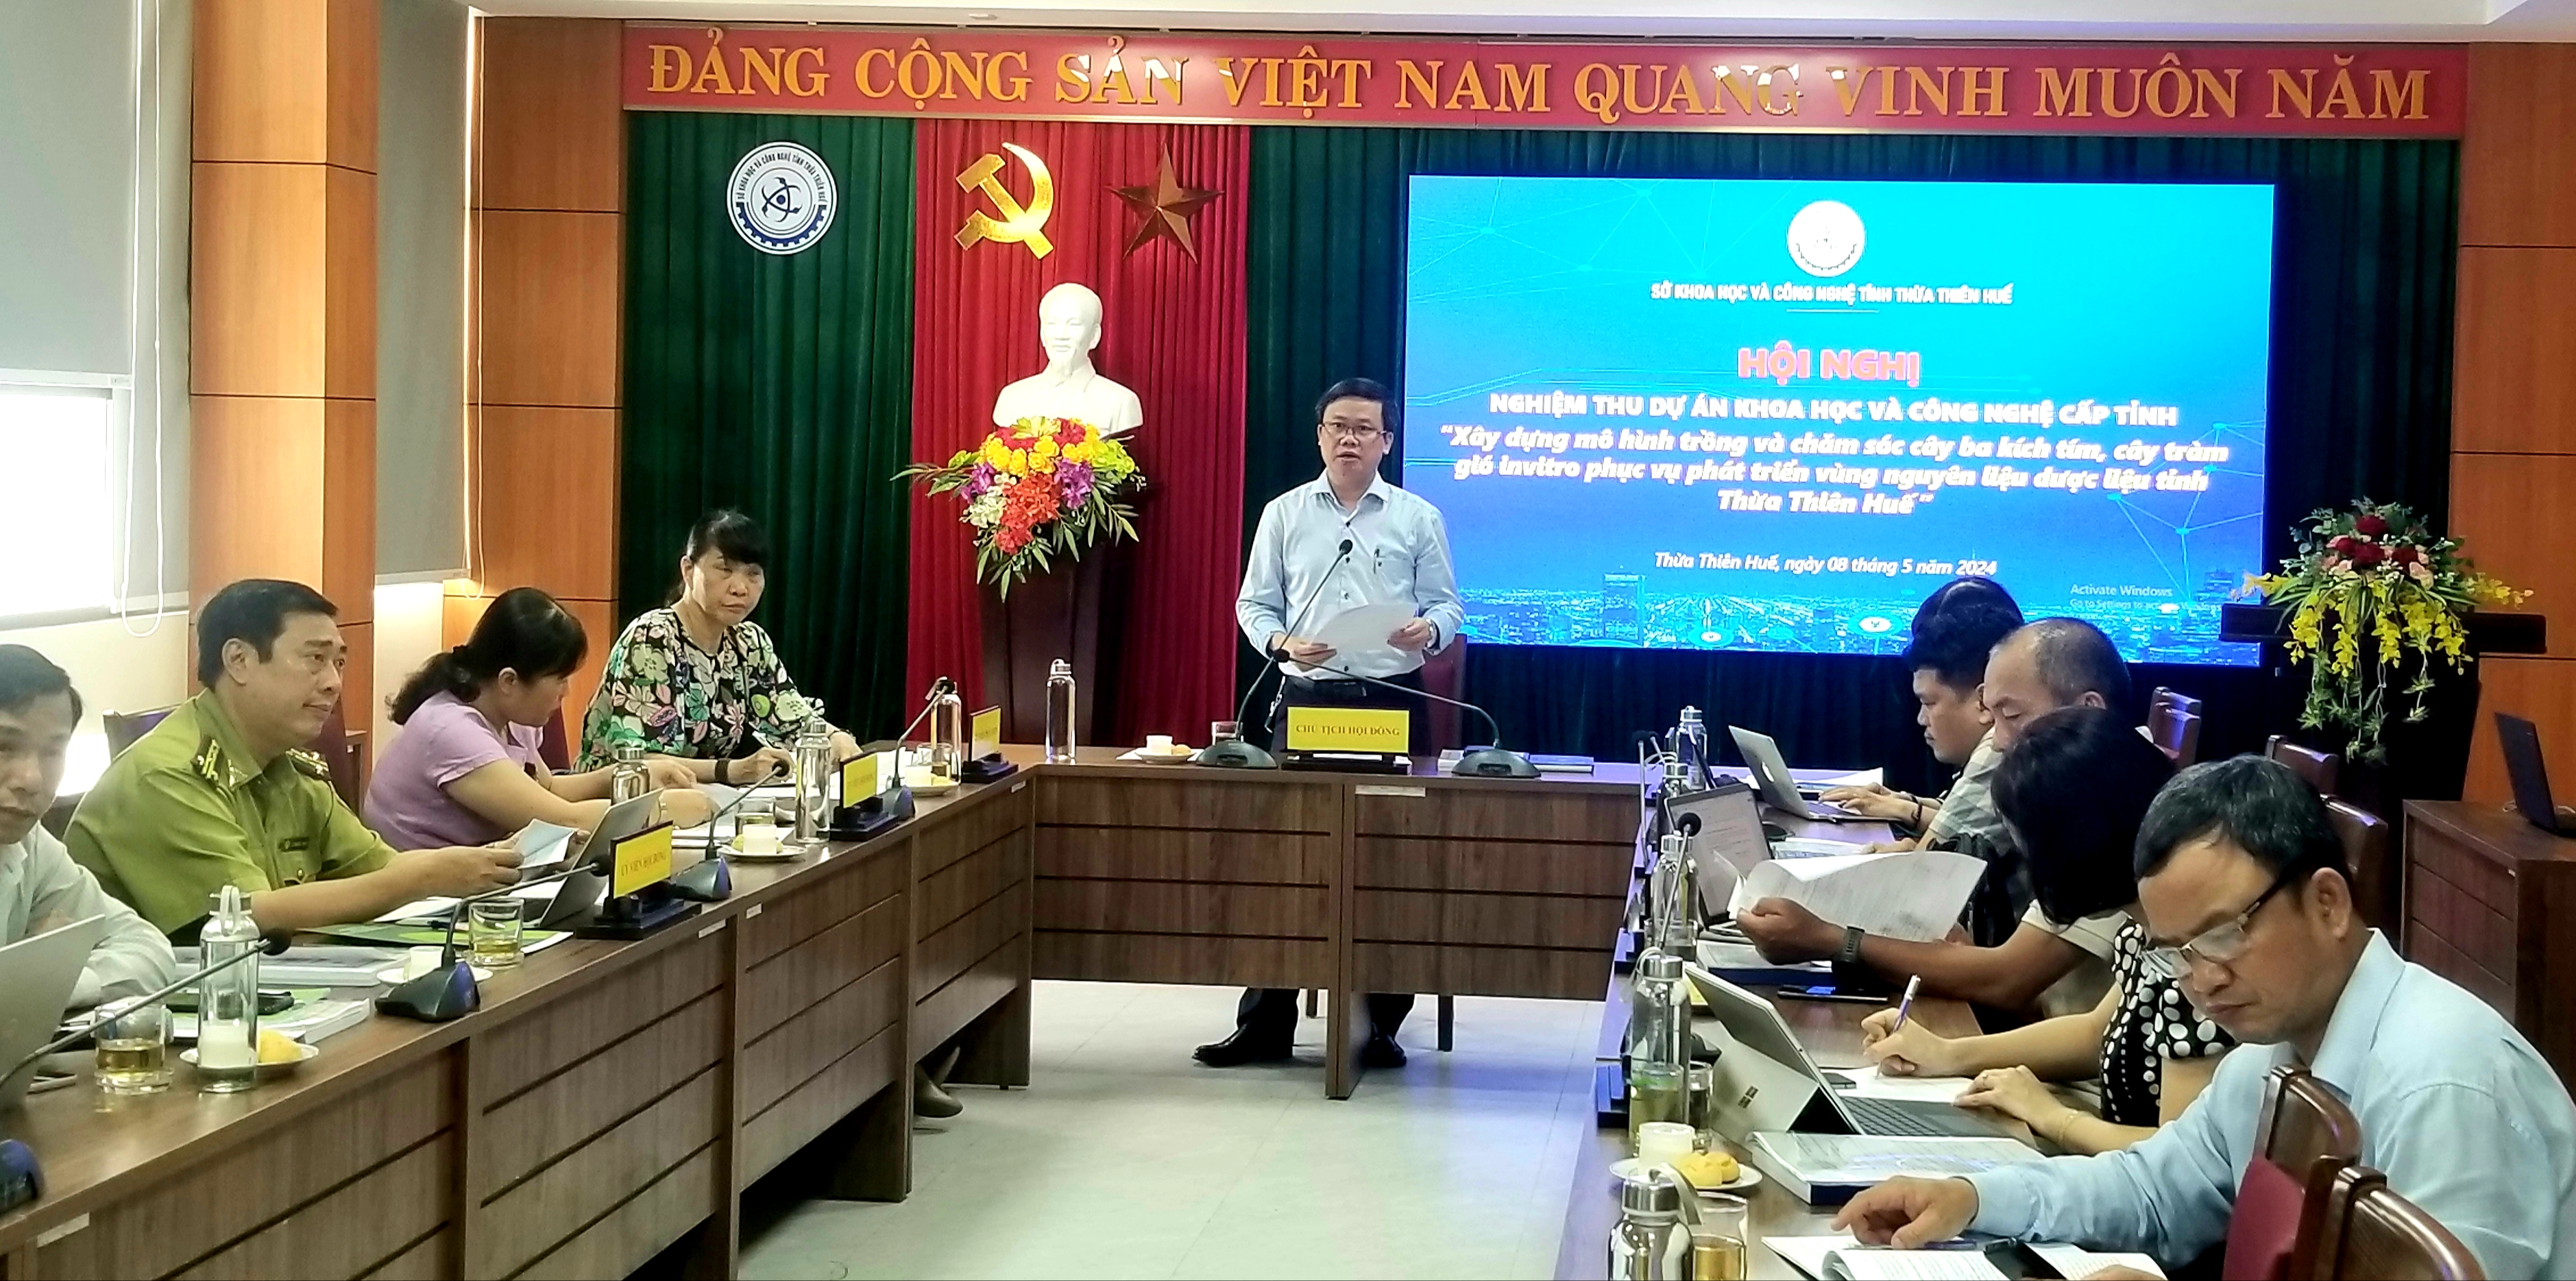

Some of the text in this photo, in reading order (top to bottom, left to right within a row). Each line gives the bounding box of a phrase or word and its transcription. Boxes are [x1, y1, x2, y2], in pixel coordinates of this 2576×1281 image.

[647, 27, 2431, 124] ĐẢNG CỘNG SẢN VIỆT NAM QUANG VINH MUÔN NĂM
[1651, 280, 2014, 306] SỞ KHOA HỌC VÀ CÔNG NGHỆ TỈNH THỪA THIÊN HUẾ
[1737, 341, 1921, 387] HỘI NGHỊ
[1490, 391, 2178, 428] NGHIỆM THU DỰ ÁN KHOA HỌC VÀ CÔNG NGHỆ CẤP TỈNH
[1505, 428, 1570, 452] dựng
[1573, 429, 1614, 449] mô
[1618, 429, 1675, 451] hình
[1679, 430, 1748, 457] trồng
[1753, 432, 1786, 453] và
[1790, 432, 1860, 455] chăm
[1862, 435, 1904, 455] sóc
[1908, 435, 1956, 461] cây
[1958, 436, 1993, 457] ba
[1996, 436, 2052, 460] kích
[2055, 438, 2106, 462] tím,
[2113, 439, 2160, 466] cây
[2163, 441, 2229, 462] tràm
[1455, 455, 2209, 494] gió invitro phục vụ phát triển vùng nguyên liệu dược liệu tỉnh
[1717, 490, 1782, 511] Thừa
[1788, 491, 1857, 513] Thiên
[1655, 552, 1997, 577] Thừa Thiên Huế, ngày 08 tháng 5 năm 2024
[2070, 584, 2173, 597] Activate Windows
